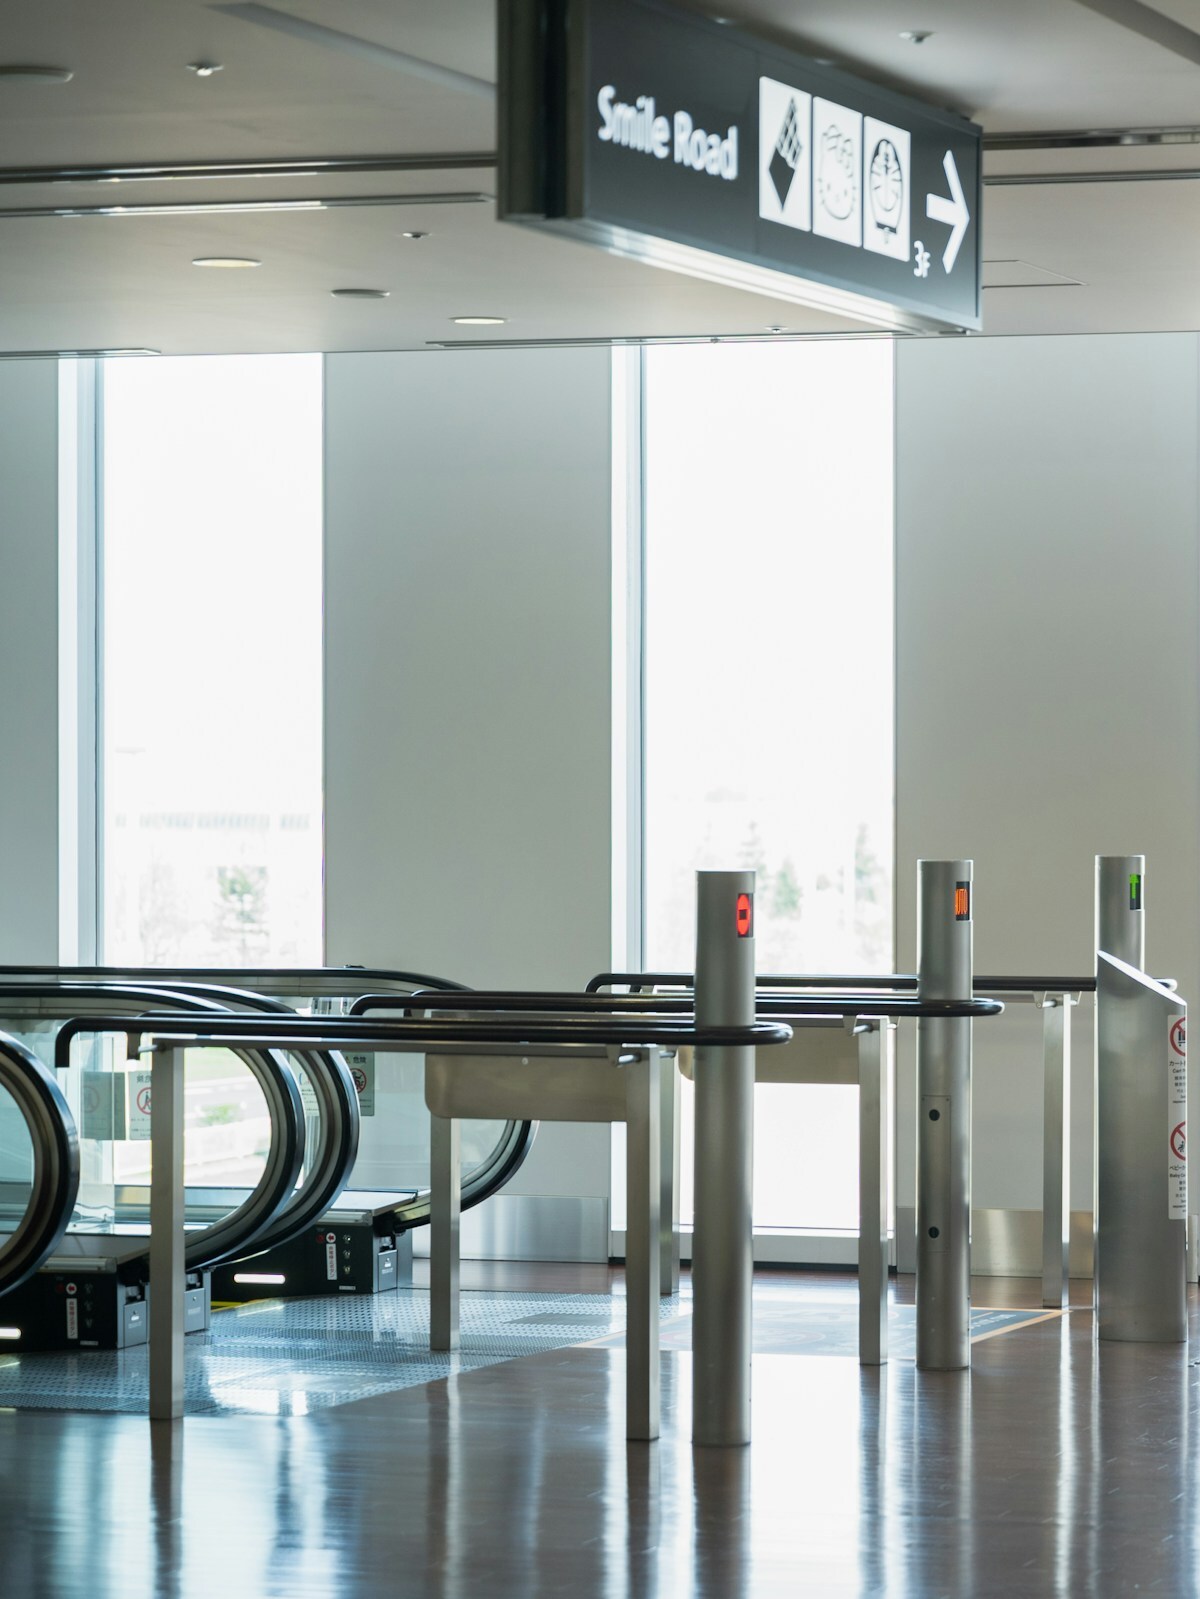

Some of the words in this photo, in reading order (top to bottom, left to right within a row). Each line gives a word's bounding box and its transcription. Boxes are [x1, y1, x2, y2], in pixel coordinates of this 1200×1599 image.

[597, 84, 671, 159] Smile
[673, 109, 739, 181] Road
[913, 239, 931, 279] 3F
